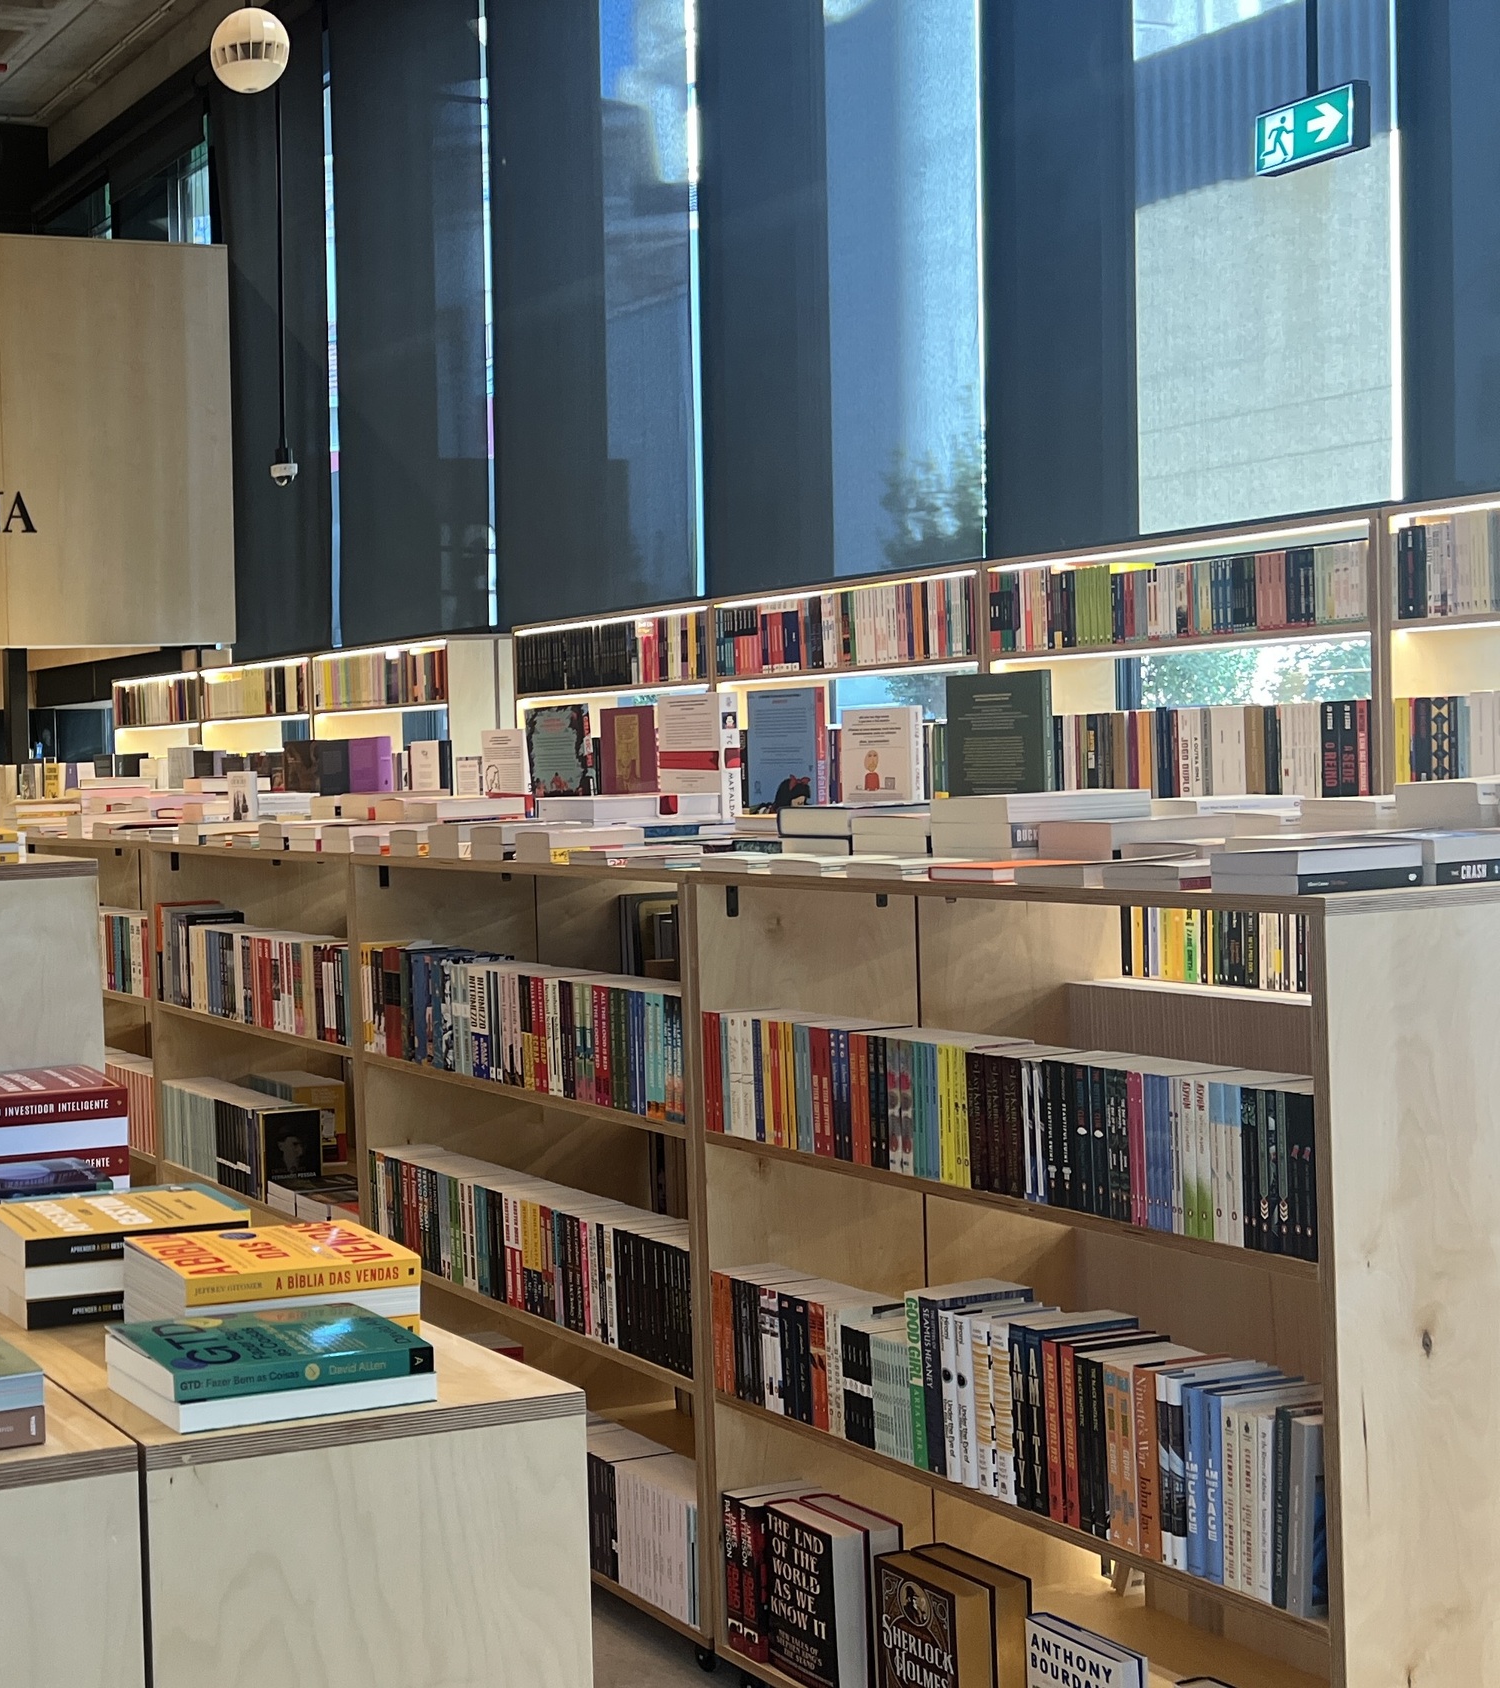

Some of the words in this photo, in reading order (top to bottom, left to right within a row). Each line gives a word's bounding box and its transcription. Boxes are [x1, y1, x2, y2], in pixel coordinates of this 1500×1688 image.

[1181, 737, 1190, 762] JOGO
[817, 759, 827, 804] Mafalda
[1181, 763, 1191, 793] DUPLO
[1325, 751, 1337, 787] REINO
[1342, 754, 1354, 783] SEDE
[727, 772, 736, 818] MAFALDA
[1461, 864, 1487, 880] CRASH
[469, 976, 477, 1027] INTERMEZZO
[477, 977, 486, 1029] INTERMEZZO
[5, 1103, 55, 1116] INVESTIDOR
[58, 1099, 109, 1113] INTELIGENTE
[70, 1244, 95, 1253] APRENDER
[238, 1241, 290, 1260] DAS
[284, 1222, 394, 1264] VENDAS
[188, 1265, 240, 1275] A
[276, 1277, 283, 1291] A
[287, 1272, 324, 1290] BÍBLIA
[330, 1271, 350, 1284] DAS
[356, 1266, 399, 1283] VENDAS
[194, 1285, 226, 1296] JEFFREY
[228, 1282, 262, 1293] GITOMER
[72, 1306, 97, 1315] APRENDER
[103, 1304, 111, 1312] SER
[906, 1297, 919, 1346] GOOD
[922, 1308, 931, 1347] SEAMUS
[152, 1322, 241, 1365] GTD
[180, 1380, 204, 1391] GTD:
[206, 1377, 231, 1387] Fazer
[233, 1375, 255, 1385] Bem
[256, 1374, 267, 1382] as
[269, 1370, 299, 1381] Coisas
[329, 1364, 357, 1375] David
[358, 1360, 386, 1372] Allen
[908, 1347, 923, 1381] GIRL
[924, 1349, 933, 1389] HEANEY
[1045, 1353, 1055, 1406] AMAZING
[913, 1389, 922, 1417] ARTA
[1063, 1358, 1073, 1415] AMAZING
[1012, 1343, 1025, 1489] AMITY
[1028, 1348, 1041, 1494] AMITY
[1135, 1375, 1149, 1436] Ninette's
[915, 1421, 924, 1450] ABER
[947, 1436, 955, 1448] Eye
[949, 1449, 956, 1458] of
[961, 1442, 969, 1455] Eye
[1049, 1409, 1058, 1464] WORLDS
[1066, 1417, 1074, 1470] WORLDS
[1138, 1440, 1149, 1468] War
[1226, 1443, 1235, 1489] CEREMONY
[1139, 1476, 1153, 1511] John
[724, 1500, 732, 1558] PATTERSON
[740, 1507, 748, 1567] PATTERSON
[767, 1512, 790, 1540] THE
[794, 1527, 824, 1555] END
[1141, 1513, 1153, 1535] Jay
[1227, 1524, 1235, 1557] MARMON
[772, 1536, 788, 1557] OF
[792, 1546, 819, 1575] THE
[772, 1557, 821, 1595] WORLD
[774, 1579, 791, 1600] AS
[796, 1588, 816, 1614] WE
[770, 1595, 808, 1631] KNOW
[813, 1618, 827, 1641] IT
[776, 1636, 797, 1655] STEPHEN
[799, 1646, 823, 1667] KING'S
[779, 1628, 790, 1641] NEW
[791, 1633, 808, 1652] TALES
[809, 1645, 818, 1655] OF
[783, 1646, 794, 1658] THE
[795, 1652, 816, 1671] STAND
[882, 1613, 954, 1675] SHERLOCK
[1030, 1633, 1112, 1684] ANTHONY
[894, 1650, 950, 1688] HOLMES
[1031, 1652, 1105, 1688] BOURDA
